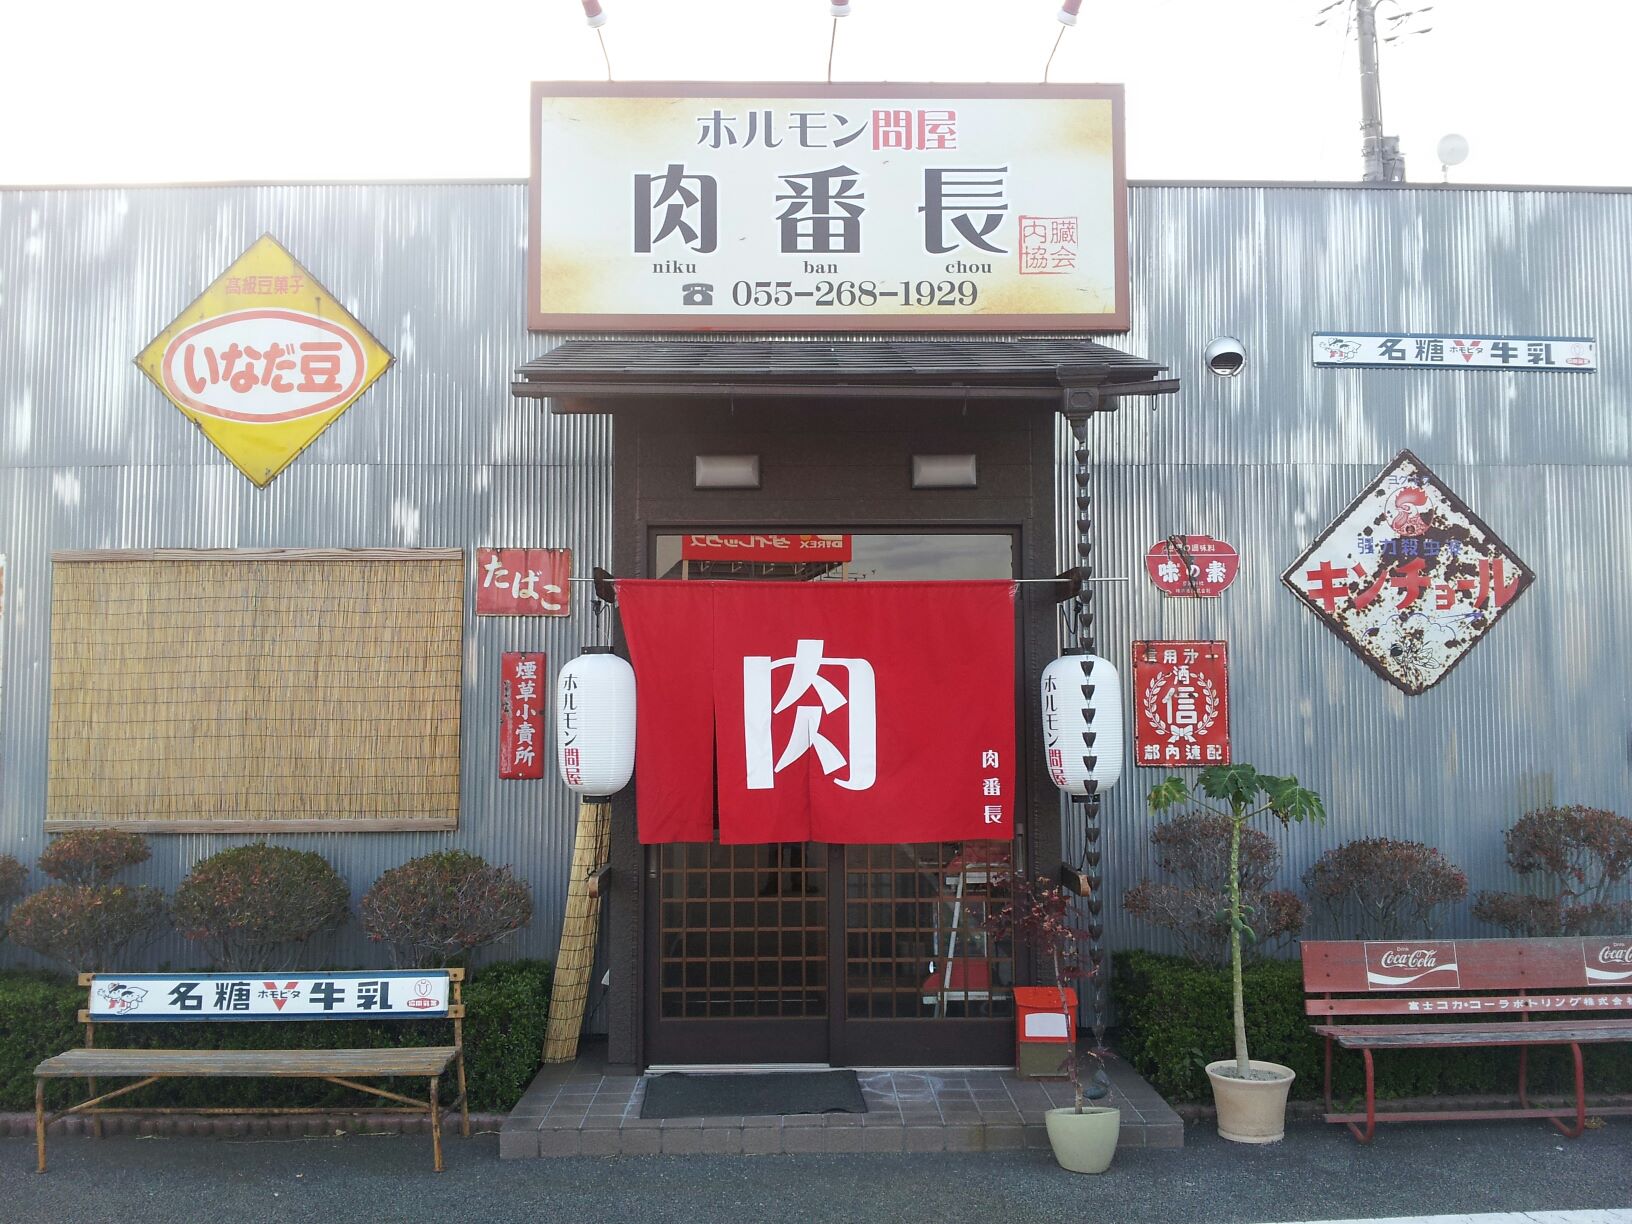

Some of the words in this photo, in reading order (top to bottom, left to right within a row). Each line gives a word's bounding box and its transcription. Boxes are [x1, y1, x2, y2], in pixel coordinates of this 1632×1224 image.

[697, 110, 958, 150] ホルモン問屋
[1023, 220, 1077, 244] 内臓
[652, 260, 697, 274] niku
[803, 260, 839, 274] ban
[945, 260, 993, 274] chou
[1020, 245, 1077, 269] 協会
[732, 280, 979, 307] 055-268-1929
[183, 342, 343, 394] いなだ豆
[1377, 339, 1444, 361] 名糖
[1490, 342, 1556, 364] 牛乳
[483, 555, 561, 611] たばこ
[1157, 560, 1227, 583] 味の素
[1306, 557, 1519, 614] キンチョール
[1173, 665, 1190, 685] 酒
[743, 639, 877, 791] 肉
[1162, 686, 1199, 725] 信
[563, 673, 582, 785] ホルモン問屋
[1044, 675, 1068, 786] ホルモン問屋
[982, 750, 1002, 824] 肉番長
[168, 982, 250, 1011] 名糖
[309, 981, 392, 1011] 牛乳
